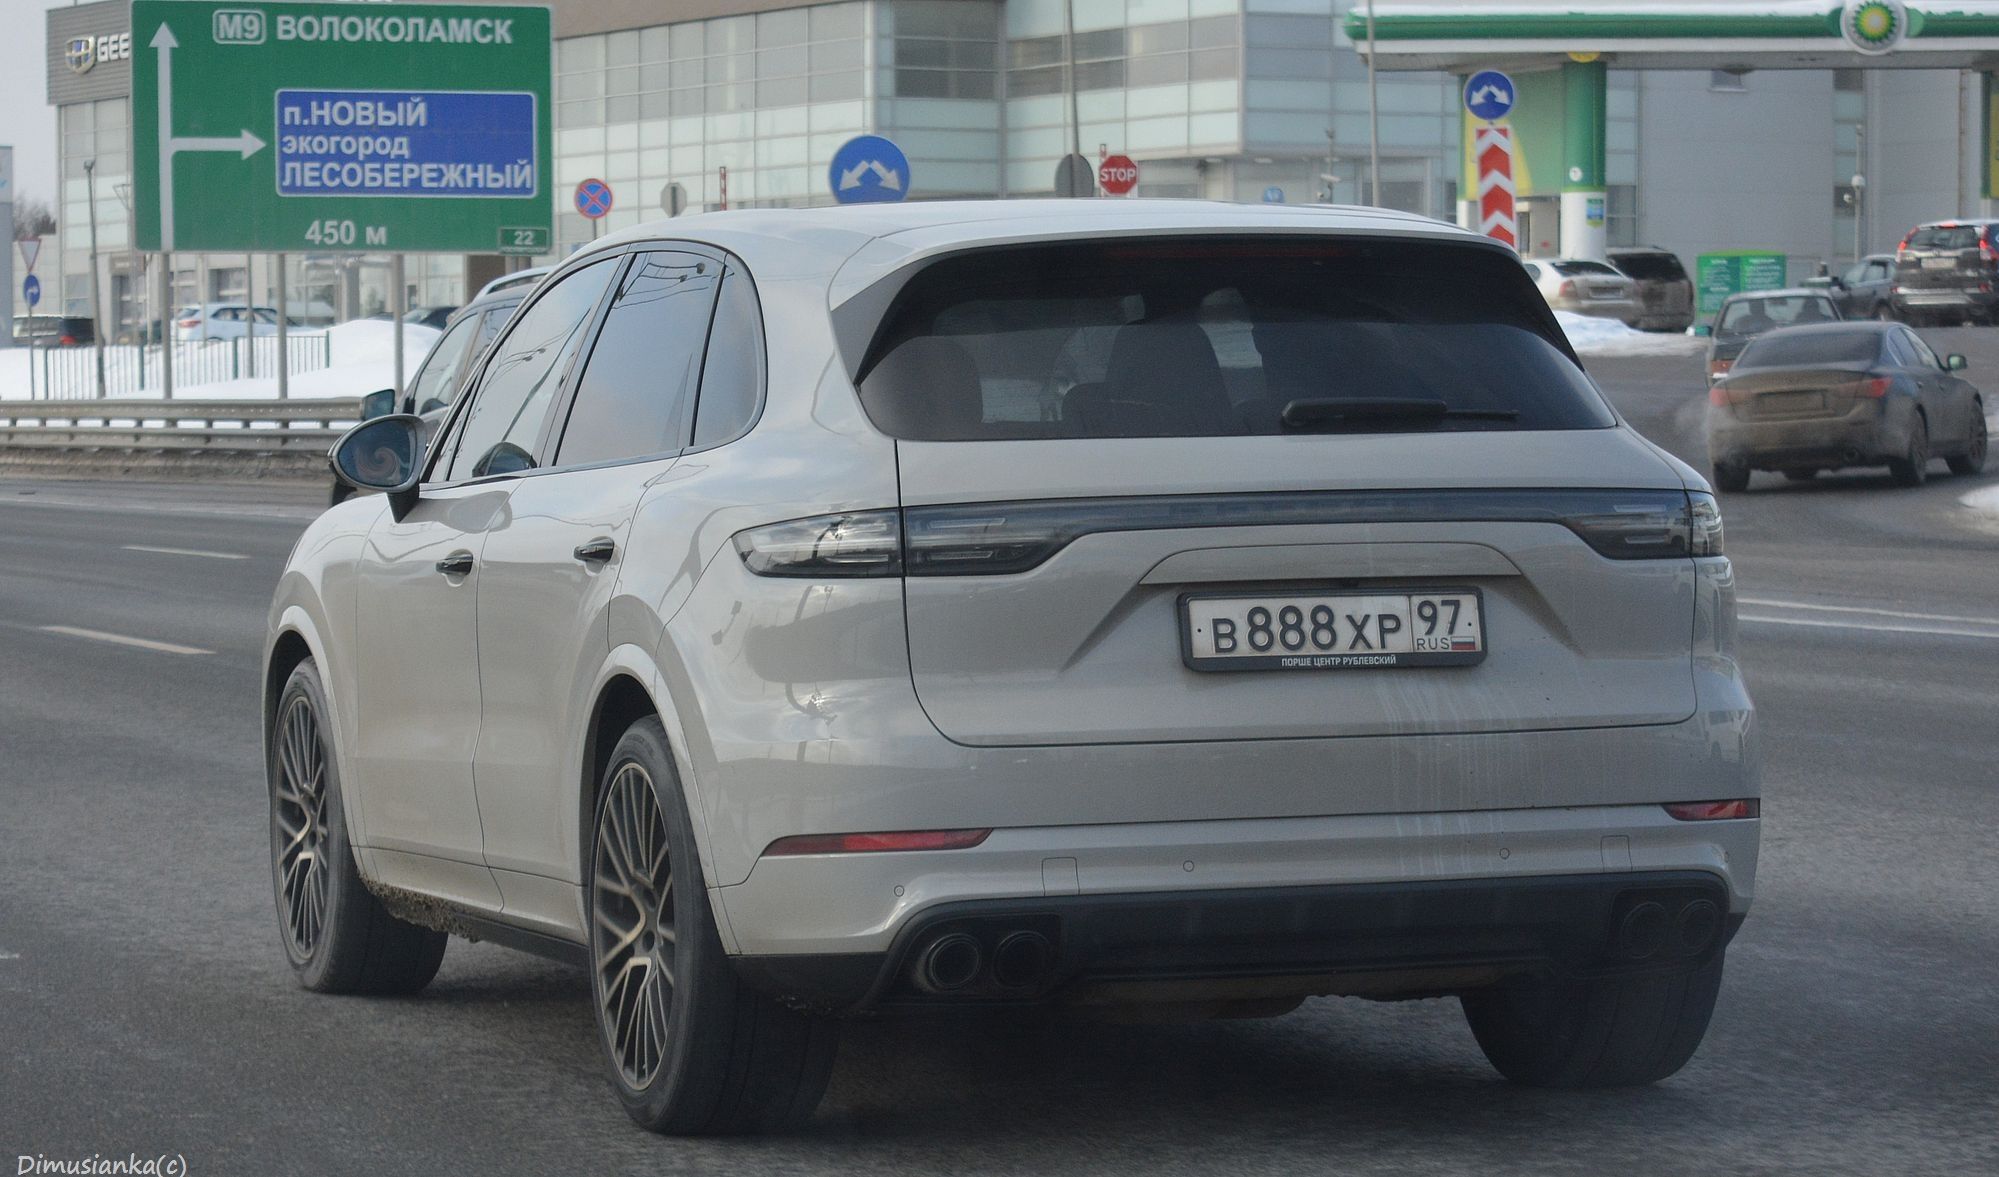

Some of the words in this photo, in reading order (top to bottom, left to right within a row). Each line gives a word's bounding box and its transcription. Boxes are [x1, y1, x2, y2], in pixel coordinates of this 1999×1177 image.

[276, 15, 513, 44] ВОЛОКОЛАМСК
[283, 96, 428, 127] п.НОВЫЙ
[282, 135, 411, 160] экогород
[282, 159, 533, 188] ЛЕСОБЕРЕЖНЫЙ
[1100, 168, 1136, 182] STOP
[305, 220, 356, 245] 450
[514, 231, 534, 245] 22
[1417, 600, 1461, 635] 97
[1416, 638, 1450, 650] RUS
[1281, 657, 1312, 667] ПОРШЕ
[1313, 656, 1342, 666] ЦЕНТР
[1342, 654, 1396, 666] РУБЛЕВСКИЙ
